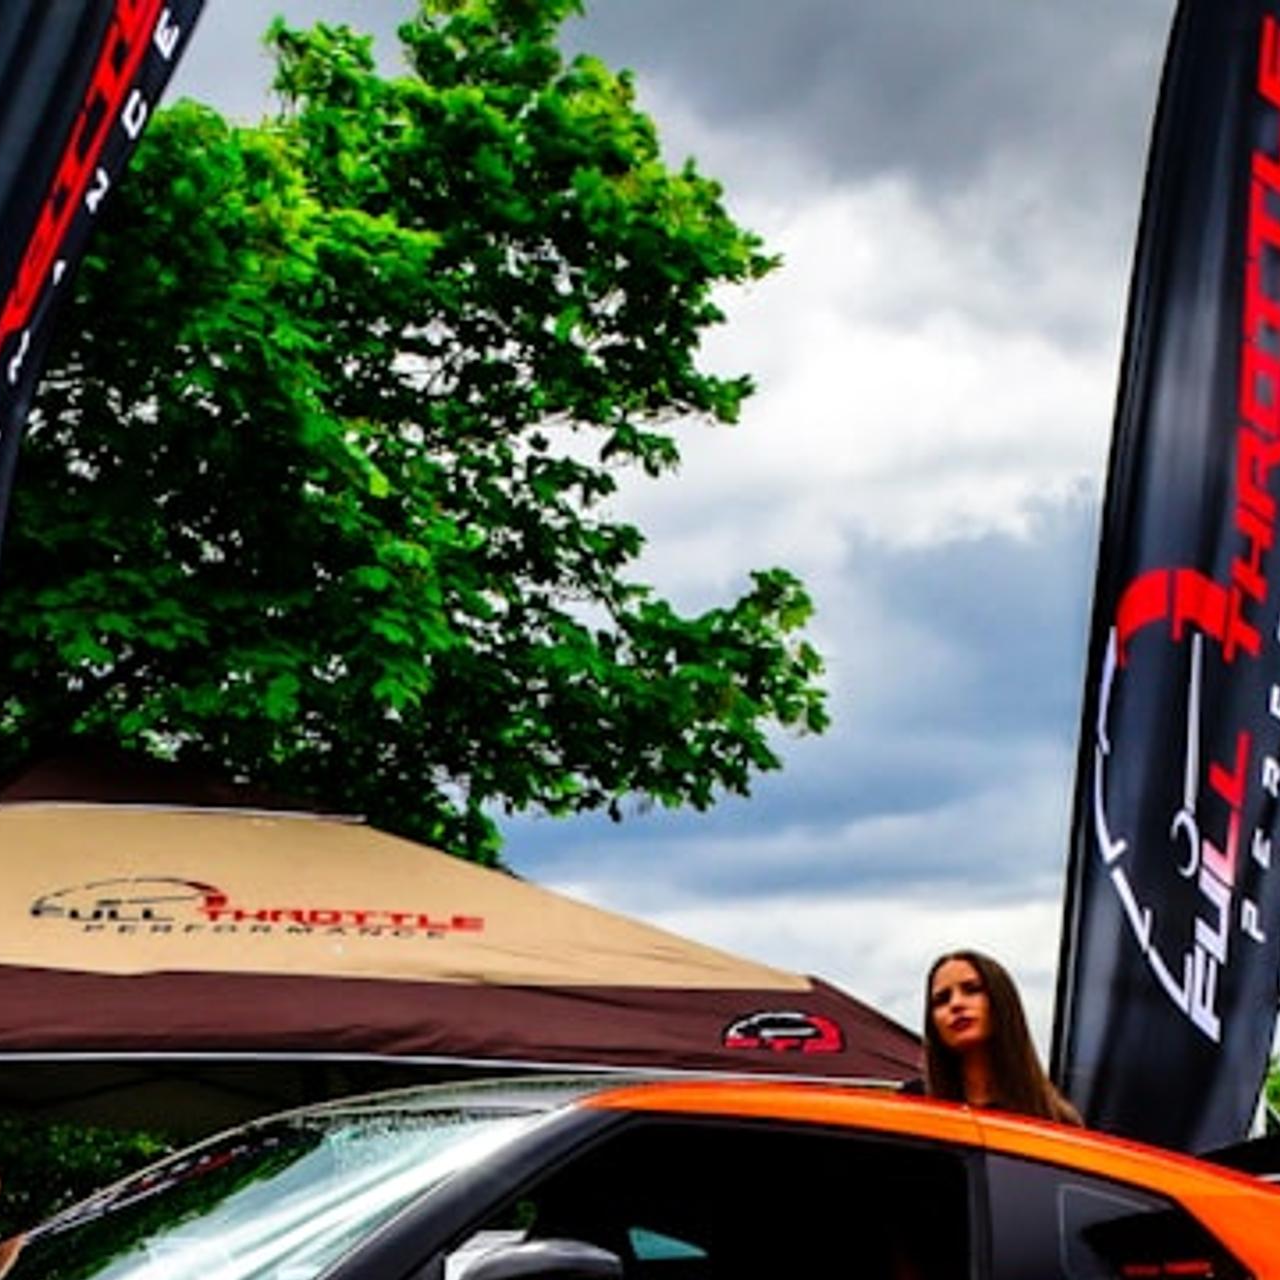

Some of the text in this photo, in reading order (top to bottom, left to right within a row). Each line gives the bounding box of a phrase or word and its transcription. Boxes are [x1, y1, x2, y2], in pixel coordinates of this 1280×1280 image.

[1190, 730, 1252, 1043] FULL
[30, 905, 486, 932] FULL THROTTLE
[82, 923, 447, 939] PERFORMANCE
